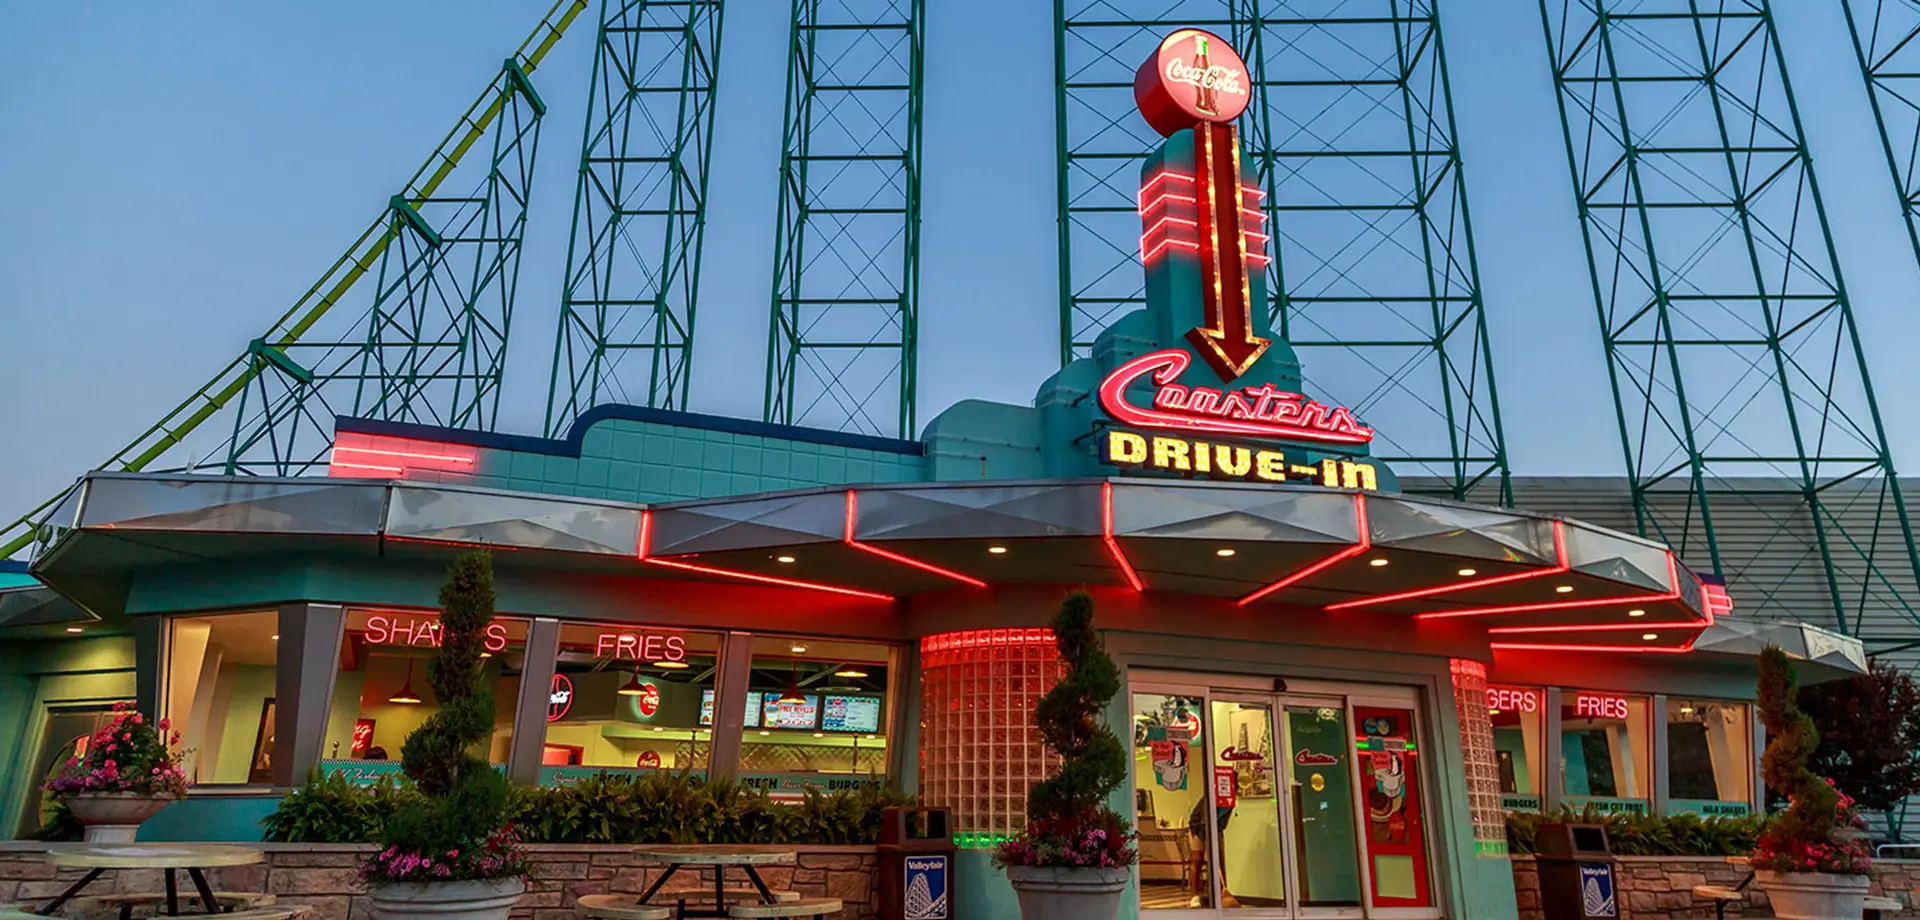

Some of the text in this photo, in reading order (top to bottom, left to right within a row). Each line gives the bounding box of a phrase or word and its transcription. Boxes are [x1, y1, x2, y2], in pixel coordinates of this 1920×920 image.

[1166, 57, 1243, 95] Coca-Cola
[1100, 348, 1374, 443] Coasters
[365, 616, 507, 651] SHAS
[597, 634, 685, 661] FRIES
[1577, 696, 1628, 718] FRIES
[828, 779, 880, 791] BURGS
